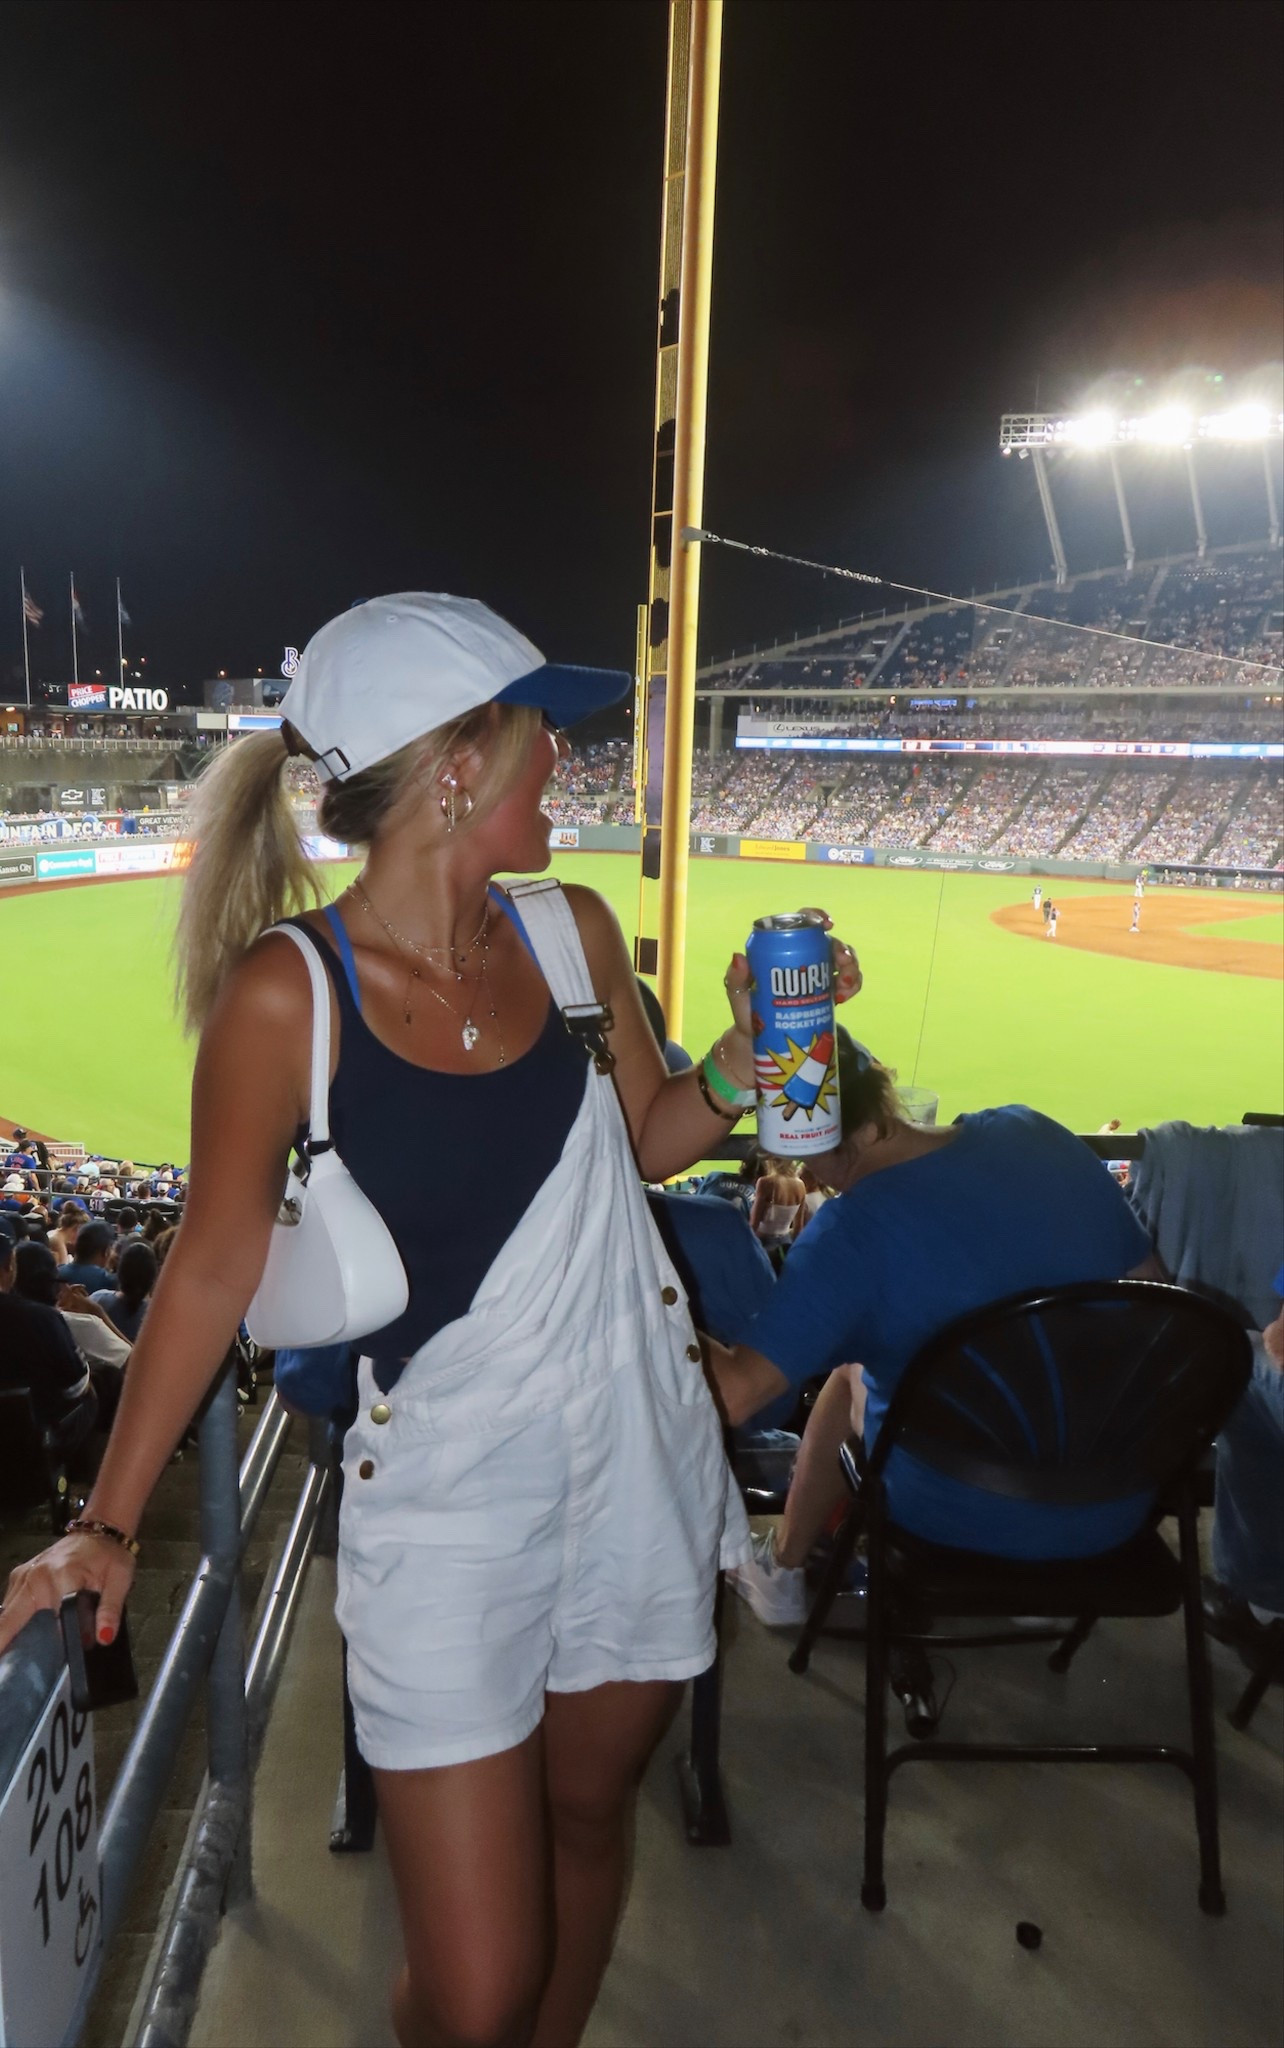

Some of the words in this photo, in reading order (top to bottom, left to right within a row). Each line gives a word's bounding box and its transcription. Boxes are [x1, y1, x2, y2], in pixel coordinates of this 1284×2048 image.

[71, 686, 92, 697] PRICE
[71, 694, 105, 708] CHOPPER
[109, 687, 168, 711] PATIO
[62, 820, 104, 838] DECK
[20, 863, 32, 873] City
[775, 1005, 830, 1020] RASPBERRY
[775, 1019, 815, 1029] ROCKET
[779, 1132, 799, 1140] REAL
[801, 1131, 822, 1139] FRUIT
[34, 1762, 92, 1947] 108
